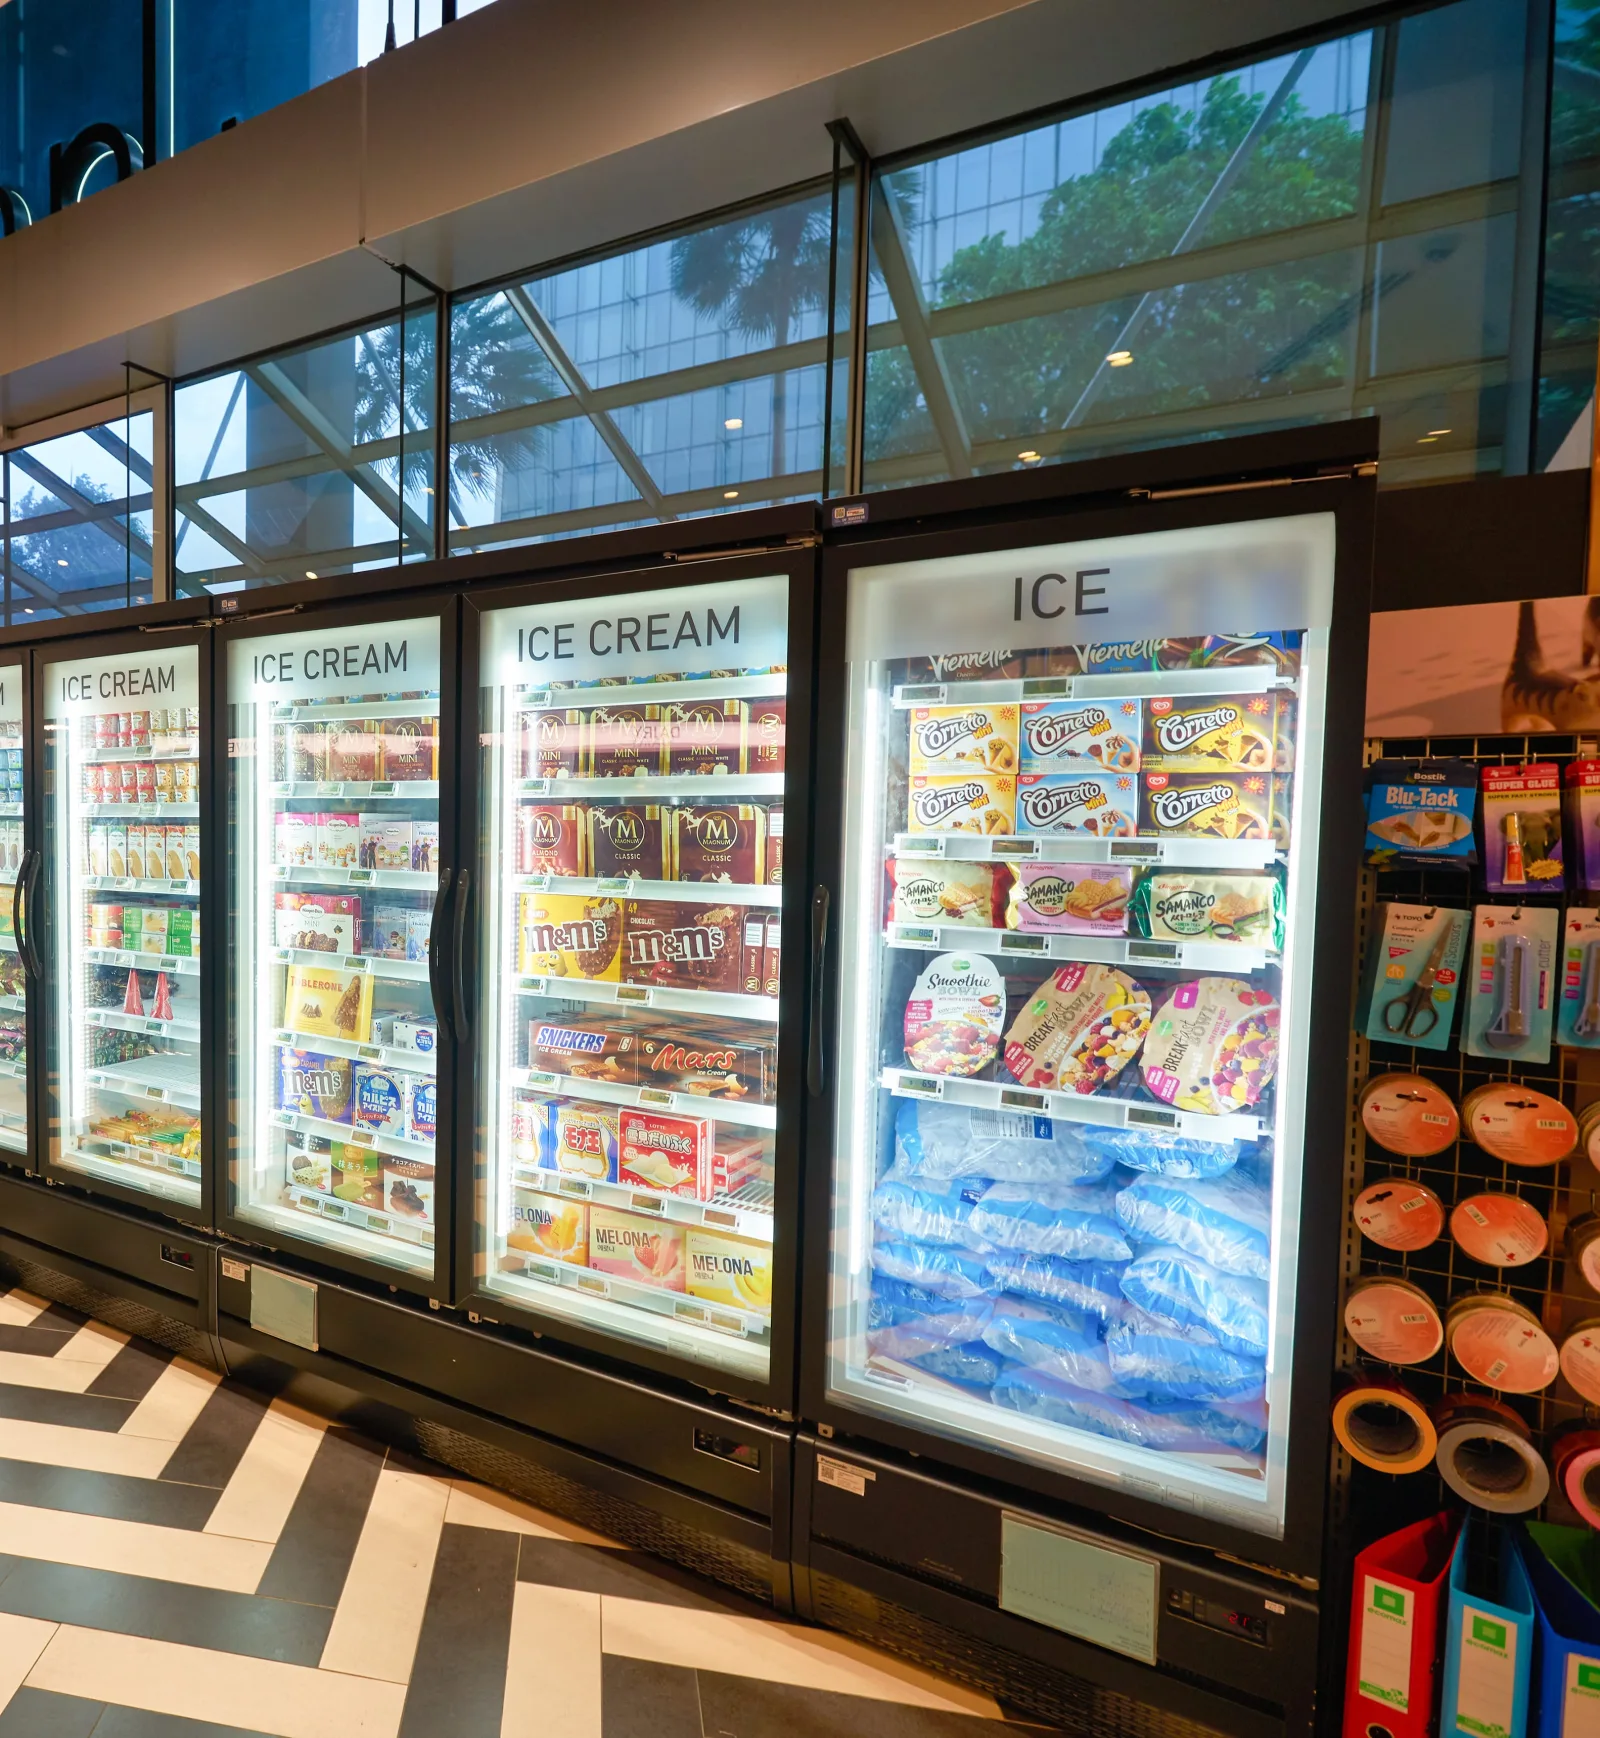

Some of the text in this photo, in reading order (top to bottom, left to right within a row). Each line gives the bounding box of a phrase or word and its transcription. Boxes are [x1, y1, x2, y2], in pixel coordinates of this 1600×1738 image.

[1013, 568, 1110, 621] ICE
[518, 606, 740, 662] ICE CREAM
[254, 640, 407, 684] ICE CREAM
[62, 665, 175, 701] ICE CREAM
[914, 713, 987, 758] Cornetto
[972, 723, 993, 740] Mini
[1025, 708, 1105, 755] Cornetto
[1088, 719, 1111, 737] Mini
[1156, 707, 1237, 752] Cornetto
[1220, 717, 1244, 735] Mini
[399, 755, 417, 763] MINI
[538, 751, 561, 761] MINI
[614, 749, 639, 758] MINI
[691, 746, 718, 755] MINI
[770, 739, 778, 761] MINI
[1489, 780, 1556, 790] SUPER GLUE
[912, 783, 983, 826] Cornetto
[969, 794, 990, 810] Mini
[1021, 782, 1101, 827] Cornetto
[1085, 793, 1108, 810] Mini
[1152, 785, 1233, 828] Cornetto
[1216, 796, 1240, 812] Mini
[1386, 786, 1458, 807] Blu-Tack
[536, 819, 554, 838] M
[617, 819, 637, 838] M
[706, 819, 728, 839] M
[1022, 881, 1075, 902] SAMANCO
[1156, 894, 1215, 918] SAMANCO
[631, 917, 655, 925] CHOCOLATE
[524, 920, 607, 953] m&m's
[628, 927, 724, 964] m&m's
[927, 973, 991, 989] Smoothie
[938, 987, 981, 996] BOWL
[1054, 987, 1095, 1032] BOWL
[1020, 997, 1071, 1053] BREAKfast
[537, 1028, 606, 1052] SNICKERS
[621, 1039, 629, 1050] 6
[646, 1043, 654, 1053] 6
[1159, 1017, 1196, 1073] BREAKfast
[652, 1043, 736, 1071] Mars
[282, 1070, 341, 1096] m&m's
[363, 1091, 397, 1108] カルピス
[363, 1102, 387, 1112] アイスバー
[565, 1124, 600, 1154] モナ王
[626, 1128, 691, 1154] 雪見だいふく
[515, 1207, 552, 1224] ELONA
[596, 1228, 651, 1248] MELONA
[692, 1255, 753, 1276] MELONA
[1367, 1607, 1407, 1626] ecomax
[1465, 1638, 1509, 1659] ecomax
